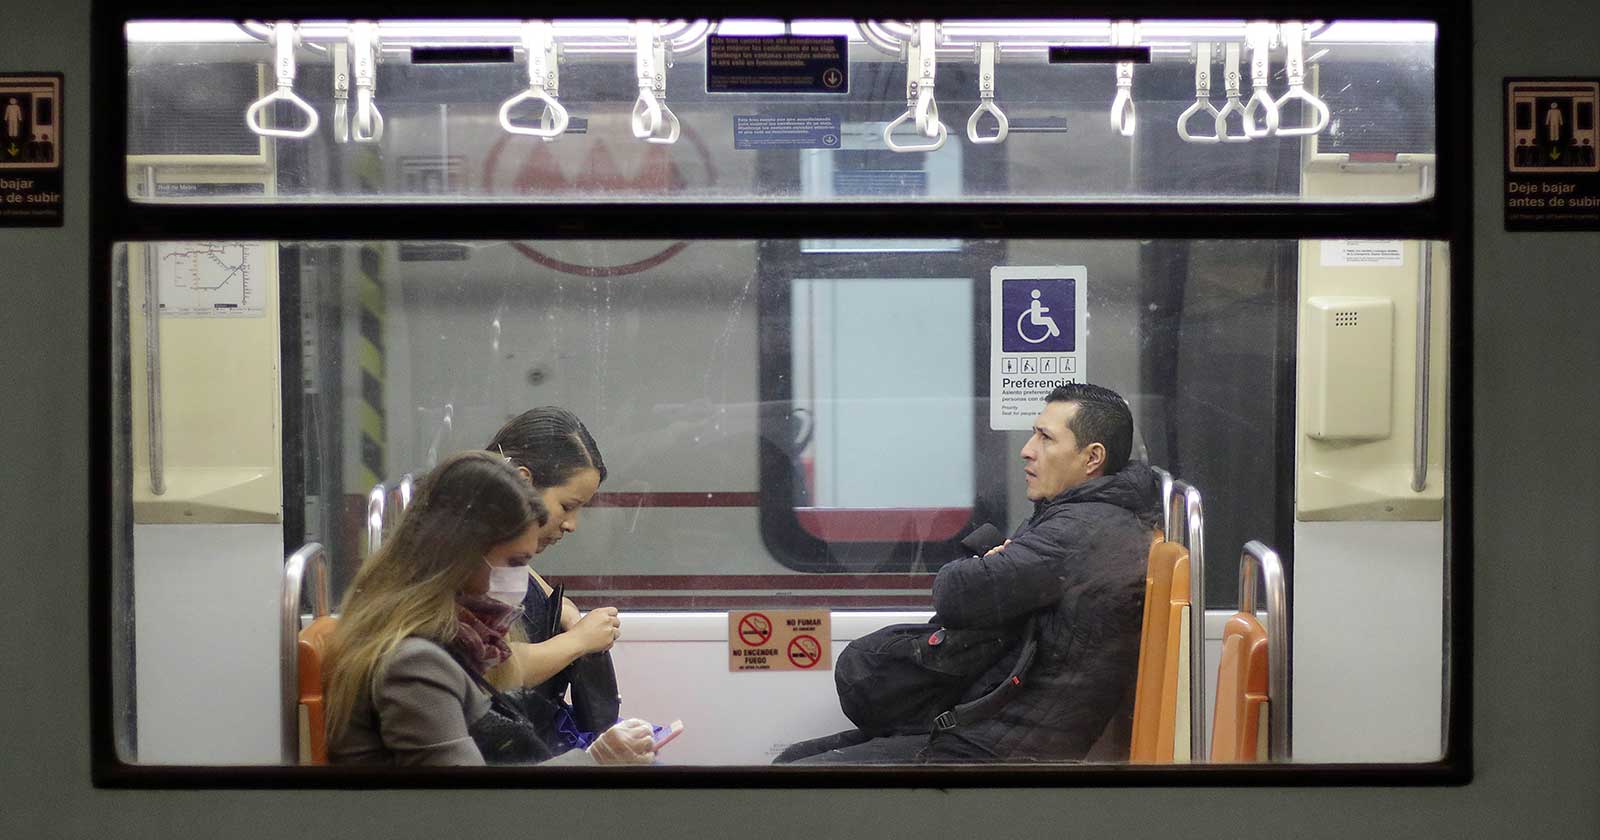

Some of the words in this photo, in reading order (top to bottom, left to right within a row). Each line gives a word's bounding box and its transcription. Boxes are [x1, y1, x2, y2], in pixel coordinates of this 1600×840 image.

[0, 178, 34, 191] bajar
[1509, 181, 1538, 194] Deje
[1542, 181, 1577, 194] bajar
[7, 192, 22, 203] de
[26, 192, 61, 203] subir
[1509, 197, 1545, 207] antes
[1548, 196, 1566, 207] de
